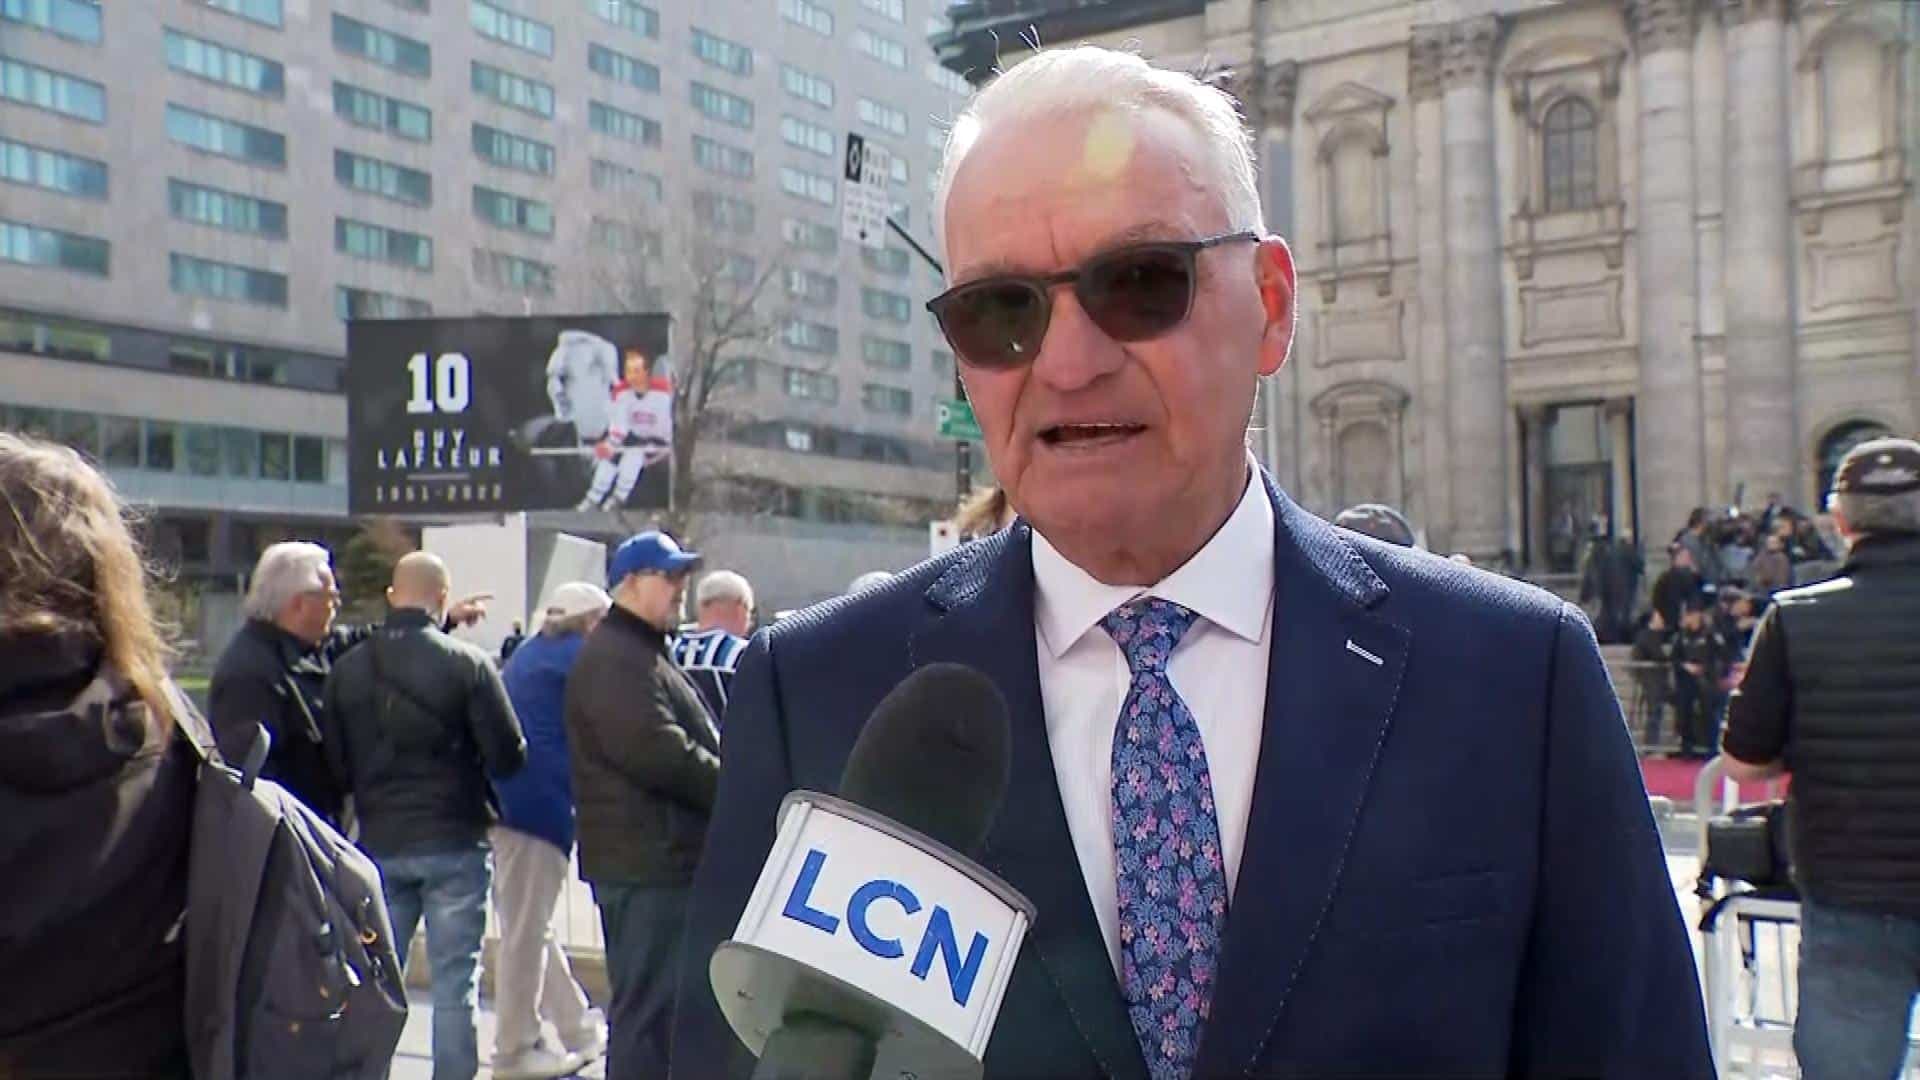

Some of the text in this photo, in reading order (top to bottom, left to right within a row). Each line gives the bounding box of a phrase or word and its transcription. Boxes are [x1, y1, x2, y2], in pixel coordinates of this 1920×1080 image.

[406, 353, 469, 413] 10
[377, 447, 500, 469] LAFLEUR
[782, 849, 989, 1008] LCN
